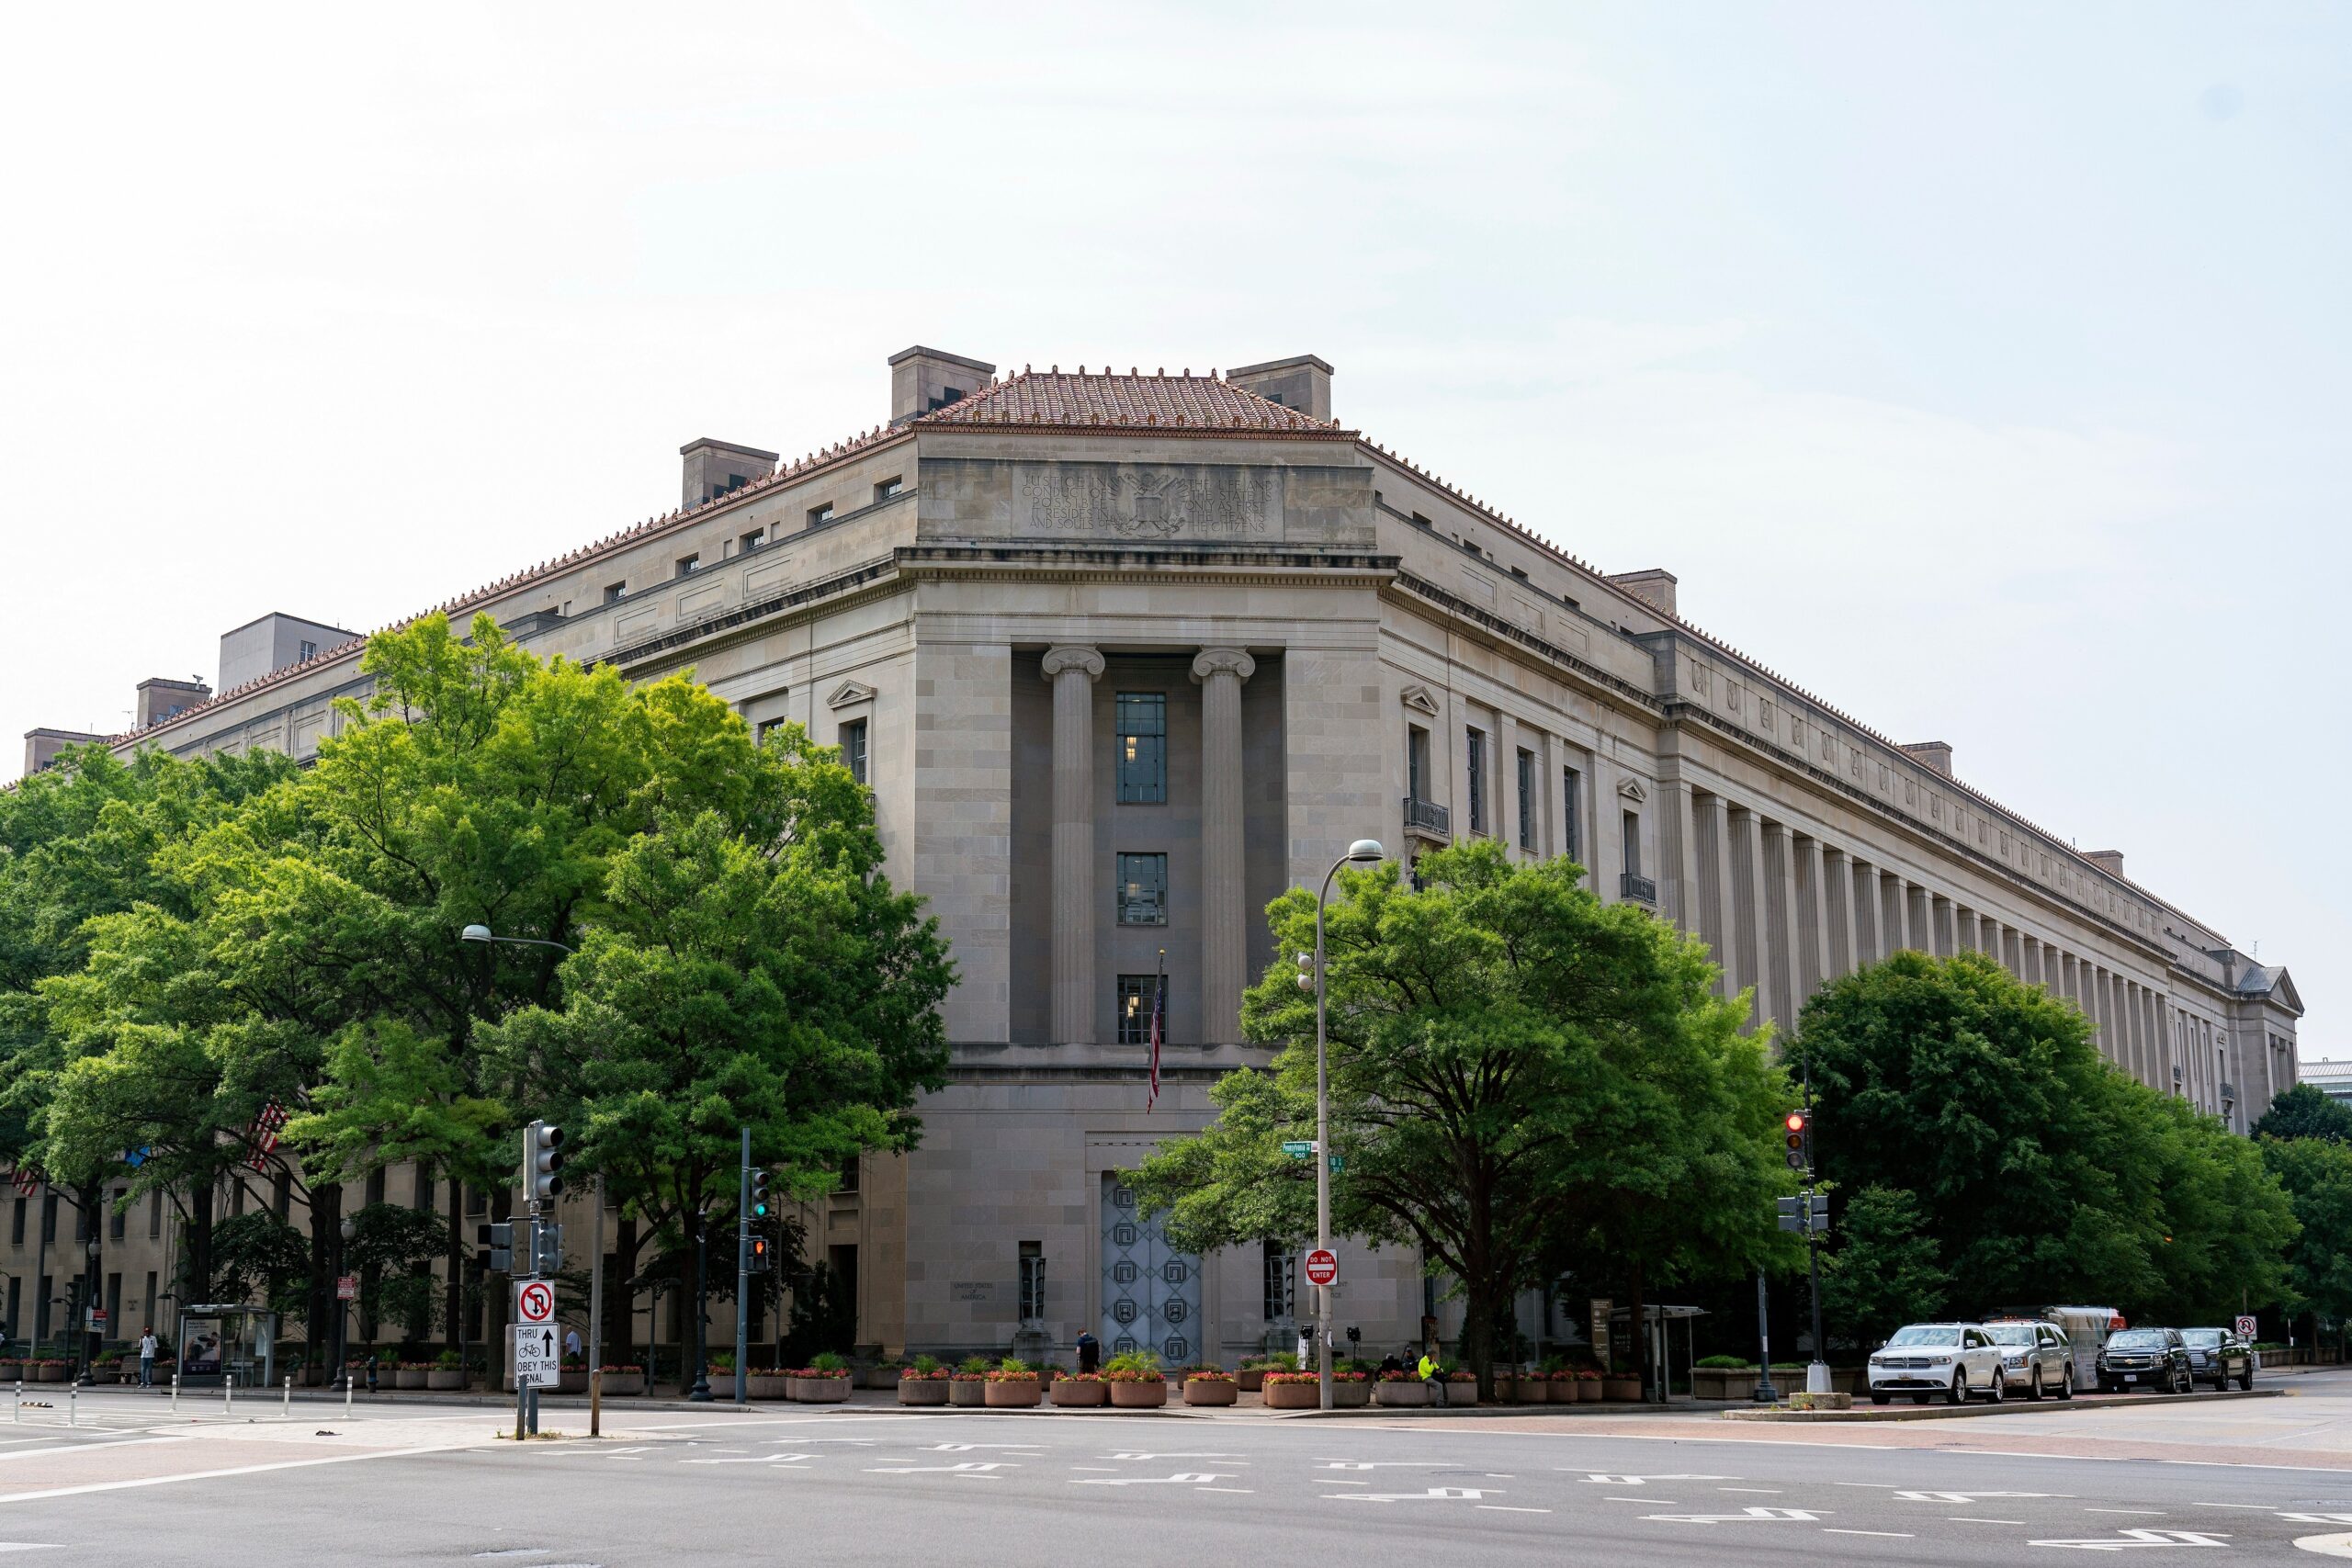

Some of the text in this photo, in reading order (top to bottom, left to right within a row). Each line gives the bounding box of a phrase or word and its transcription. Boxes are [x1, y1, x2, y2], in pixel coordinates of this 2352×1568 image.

[1023, 476, 1273, 491] JUSTICE IN THE LIFE AND
[1023, 486, 1272, 502] CONDUCT OF THE STATE IS
[1032, 497, 1265, 512] POSSIBLE ONLY AS FIRST
[1046, 508, 1092, 519] RESIDES
[1097, 509, 1109, 520] IN
[1190, 511, 1213, 522] THE
[1219, 512, 1265, 523] HEARTS
[1029, 517, 1053, 529] AND
[1057, 519, 1094, 530] SOULS
[1098, 520, 1111, 531] OF
[1187, 521, 1207, 532] THE
[517, 1328, 537, 1339] THRU
[517, 1360, 557, 1372] OBEY THIS
[517, 1373, 544, 1384] GNAL
